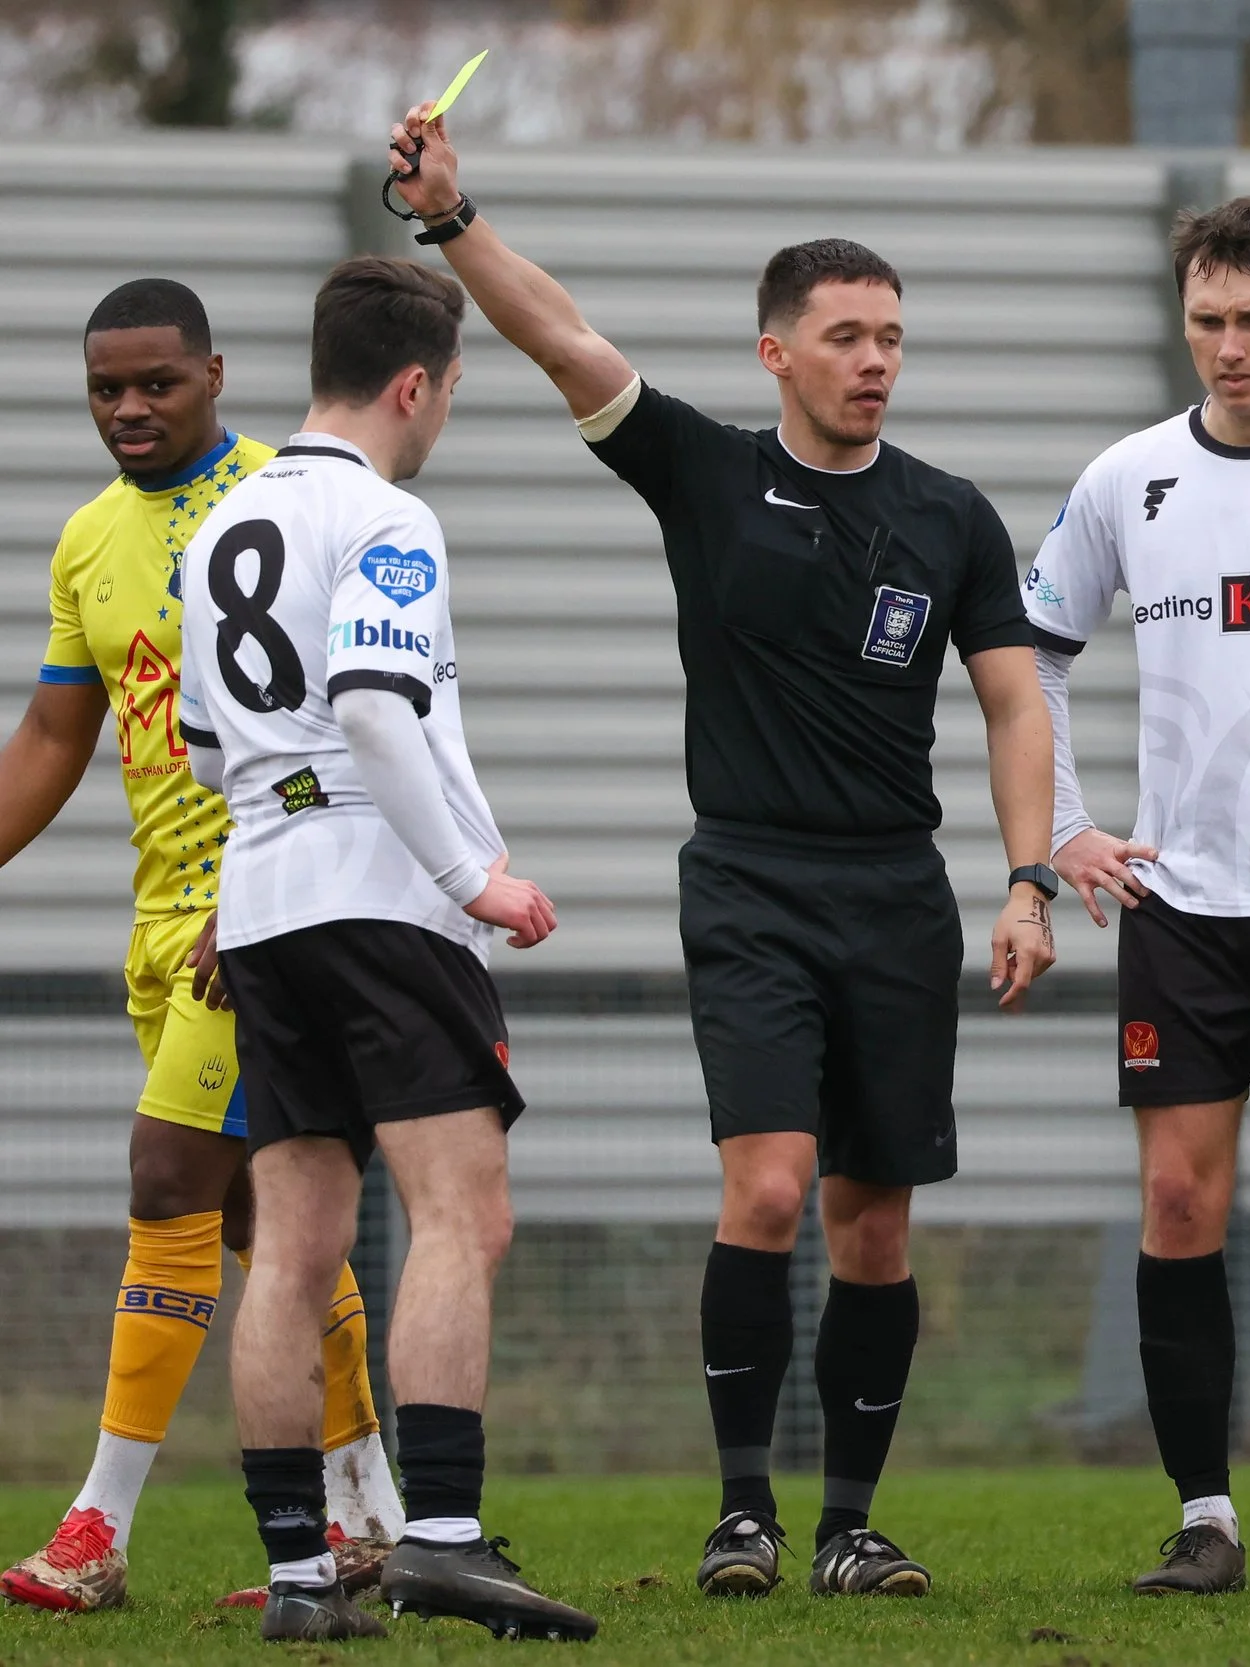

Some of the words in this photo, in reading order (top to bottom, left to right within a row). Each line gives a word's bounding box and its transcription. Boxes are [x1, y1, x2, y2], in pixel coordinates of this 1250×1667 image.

[367, 556, 387, 565] THANK
[388, 556, 401, 564] YOU
[403, 559, 411, 567] ST
[380, 567, 422, 588] NHS
[208, 519, 307, 713] 8
[328, 617, 431, 658] 71blue
[876, 638, 906, 650] MATCH
[870, 645, 906, 659] OFFICIAL
[141, 764, 163, 777] THAN
[125, 1290, 214, 1322] SCR
